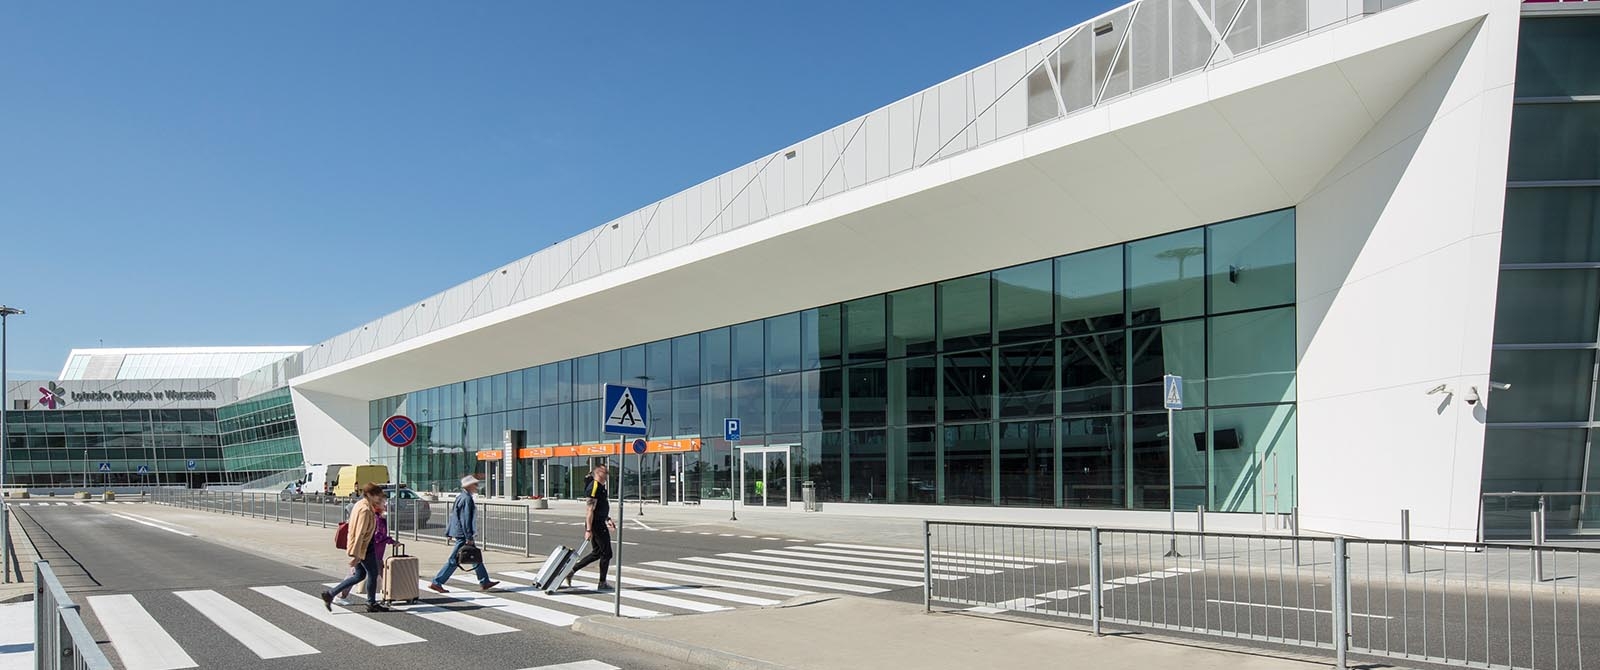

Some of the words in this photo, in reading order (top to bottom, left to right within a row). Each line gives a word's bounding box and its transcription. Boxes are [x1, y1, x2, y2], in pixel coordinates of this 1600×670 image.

[71, 390, 112, 402] Lotnisko
[113, 390, 152, 403] Chopina
[154, 391, 163, 401] w
[728, 420, 738, 435] P
